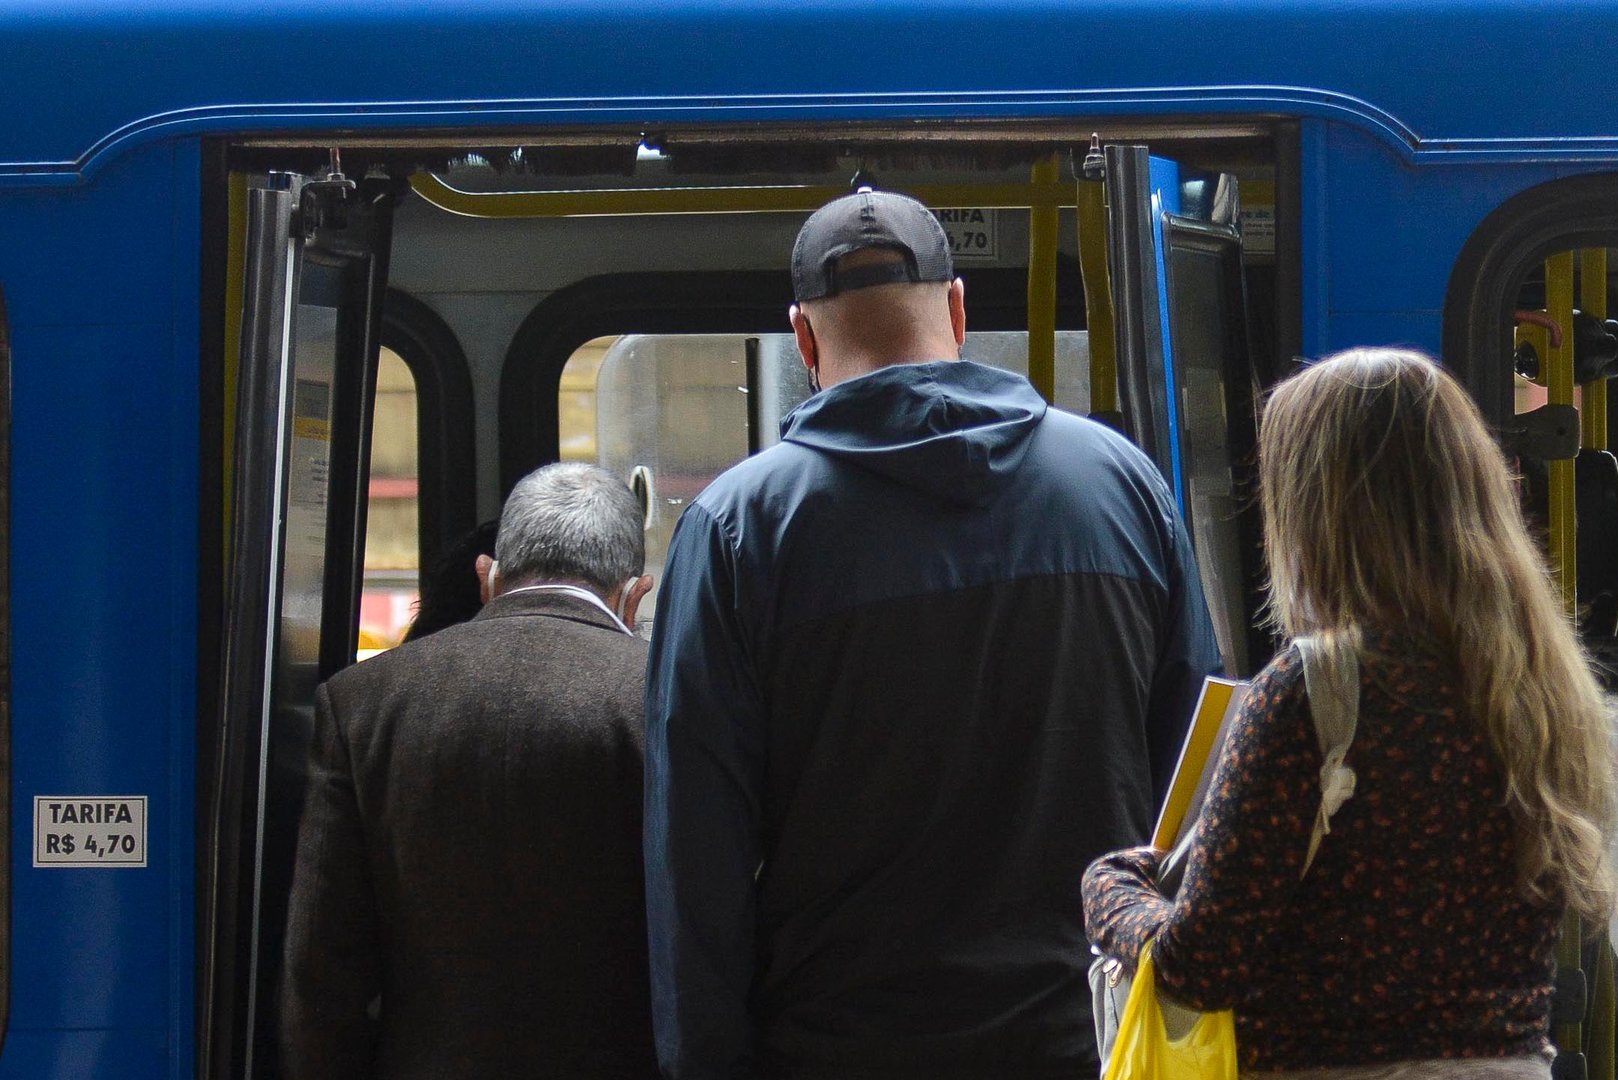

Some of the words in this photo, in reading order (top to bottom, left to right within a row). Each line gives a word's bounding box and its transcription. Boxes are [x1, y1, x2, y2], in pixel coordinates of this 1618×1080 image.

[940, 208, 985, 223] RIFA
[49, 803, 133, 824] TARIFA
[46, 833, 76, 855] R$
[84, 834, 136, 858] 4,70
